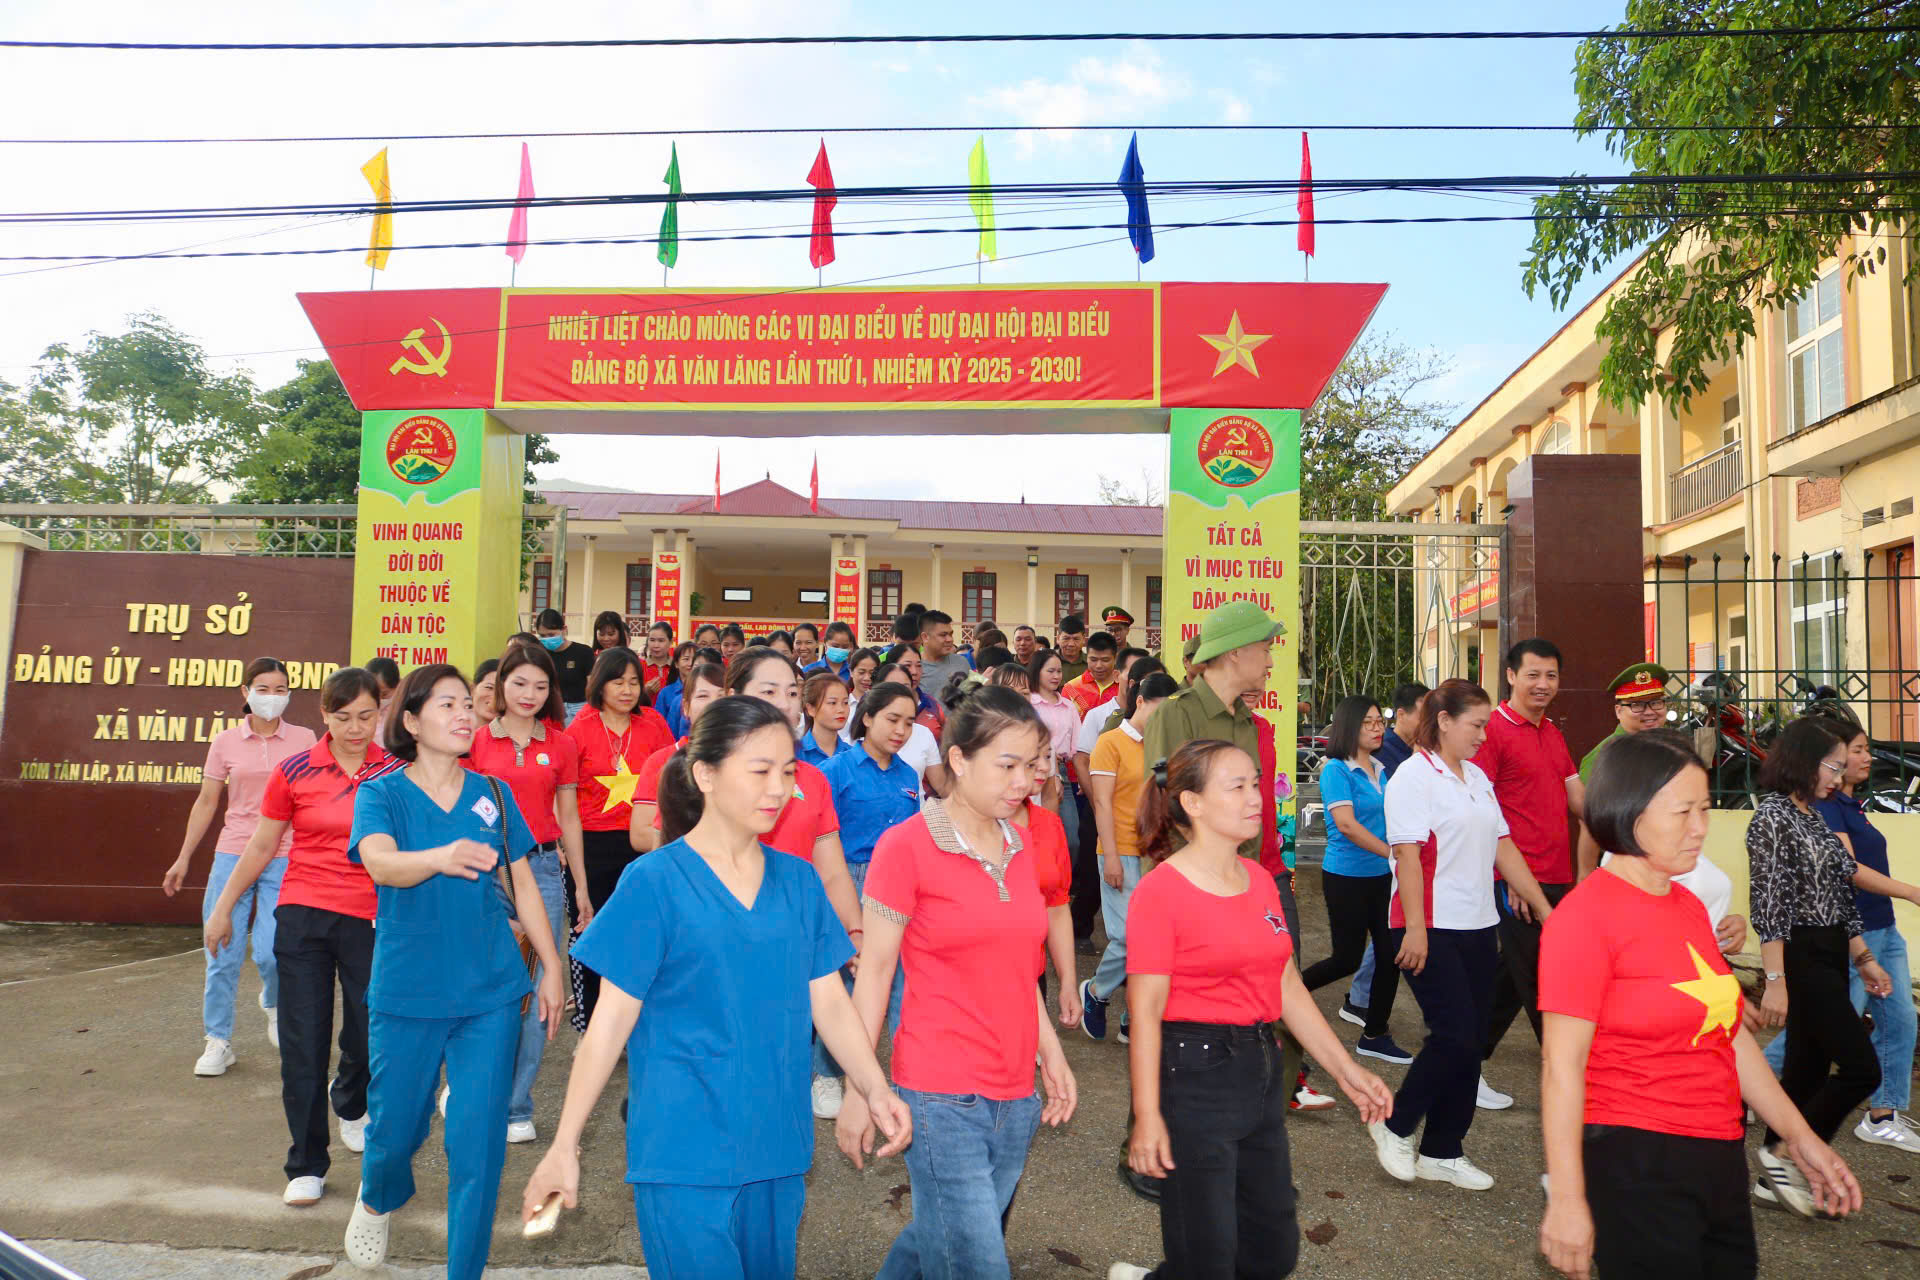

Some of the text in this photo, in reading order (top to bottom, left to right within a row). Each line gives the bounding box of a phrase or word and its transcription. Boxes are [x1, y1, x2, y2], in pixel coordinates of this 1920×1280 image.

[548, 300, 1110, 346] NHIỆT LIỆT CHÀO MỪNG CÁC VỊ ĐẠI BIỂU VỀ DỰ ĐẠI HỘI ĐẠI BIỂU
[571, 351, 620, 384] ĐẢNG
[624, 353, 648, 391] BỘ
[653, 354, 677, 384] XÃ
[683, 353, 718, 384] VĂN
[724, 353, 770, 384] LĂNG
[776, 350, 811, 384] LẦN
[817, 353, 853, 384] THỨ
[856, 358, 867, 387] I,
[873, 352, 933, 389] NHIỆM
[939, 352, 962, 383] KỲ
[967, 357, 1012, 383] 2025
[1030, 356, 1081, 382] 2030!
[373, 522, 463, 542] VINH QUANG
[1207, 521, 1263, 546] TẤT CẢ
[388, 549, 444, 571] ĐỜI ĐỜI
[1185, 555, 1283, 582] VÌ MỤC TIÊU
[379, 579, 450, 606] THUỘC VỀ
[1192, 587, 1227, 610] DÂN
[126, 591, 253, 641] TRỤ SỞ
[381, 612, 446, 638] DÂN TỘC
[14, 645, 93, 684] ĐẢNG
[103, 646, 141, 685] ỦY
[168, 658, 244, 688] HĐND
[285, 660, 340, 690] BND
[376, 643, 448, 665] VIỆT NAM
[93, 708, 129, 740] XÃ
[138, 709, 188, 742] VĂN
[20, 758, 49, 780] XÓM
[54, 760, 80, 781] TÂN
[83, 760, 112, 785] LẬP,
[115, 761, 135, 782] XÃ
[138, 761, 163, 783] VĂN
[166, 762, 203, 784] LĂNG
